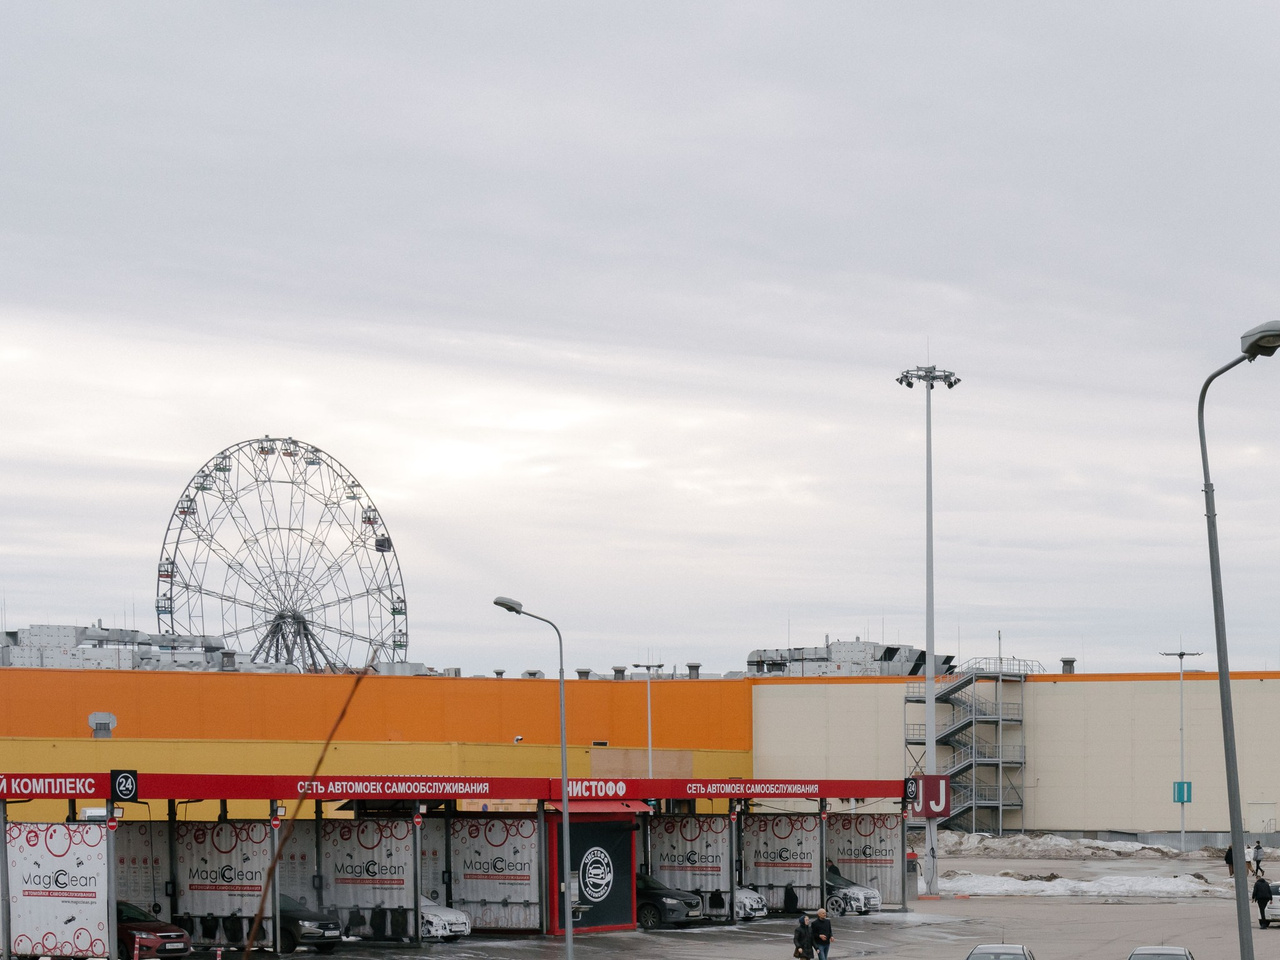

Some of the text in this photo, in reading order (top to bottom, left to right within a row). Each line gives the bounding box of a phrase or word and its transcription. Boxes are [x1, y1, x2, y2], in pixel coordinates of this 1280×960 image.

[11, 778, 95, 794] КОМПЛЕКС
[119, 778, 132, 790] 24
[297, 781, 489, 794] СЕТЬ АВТОМОЕК САМООБСЛУЖИВАНИЯ
[686, 784, 819, 794] СЕТЬ АВТОМОЕК САМООБСЛУЖИВАНИЯ
[929, 780, 946, 812] J
[584, 850, 608, 864] ЧИСТОФФ
[659, 850, 721, 865] MagiClean
[754, 847, 812, 861] MagiClean
[837, 845, 894, 858] MagiClean
[334, 860, 404, 877] MagiClean
[463, 857, 530, 873] MagiClean
[22, 869, 97, 889] MagiClean
[188, 865, 262, 883] MagiClean
